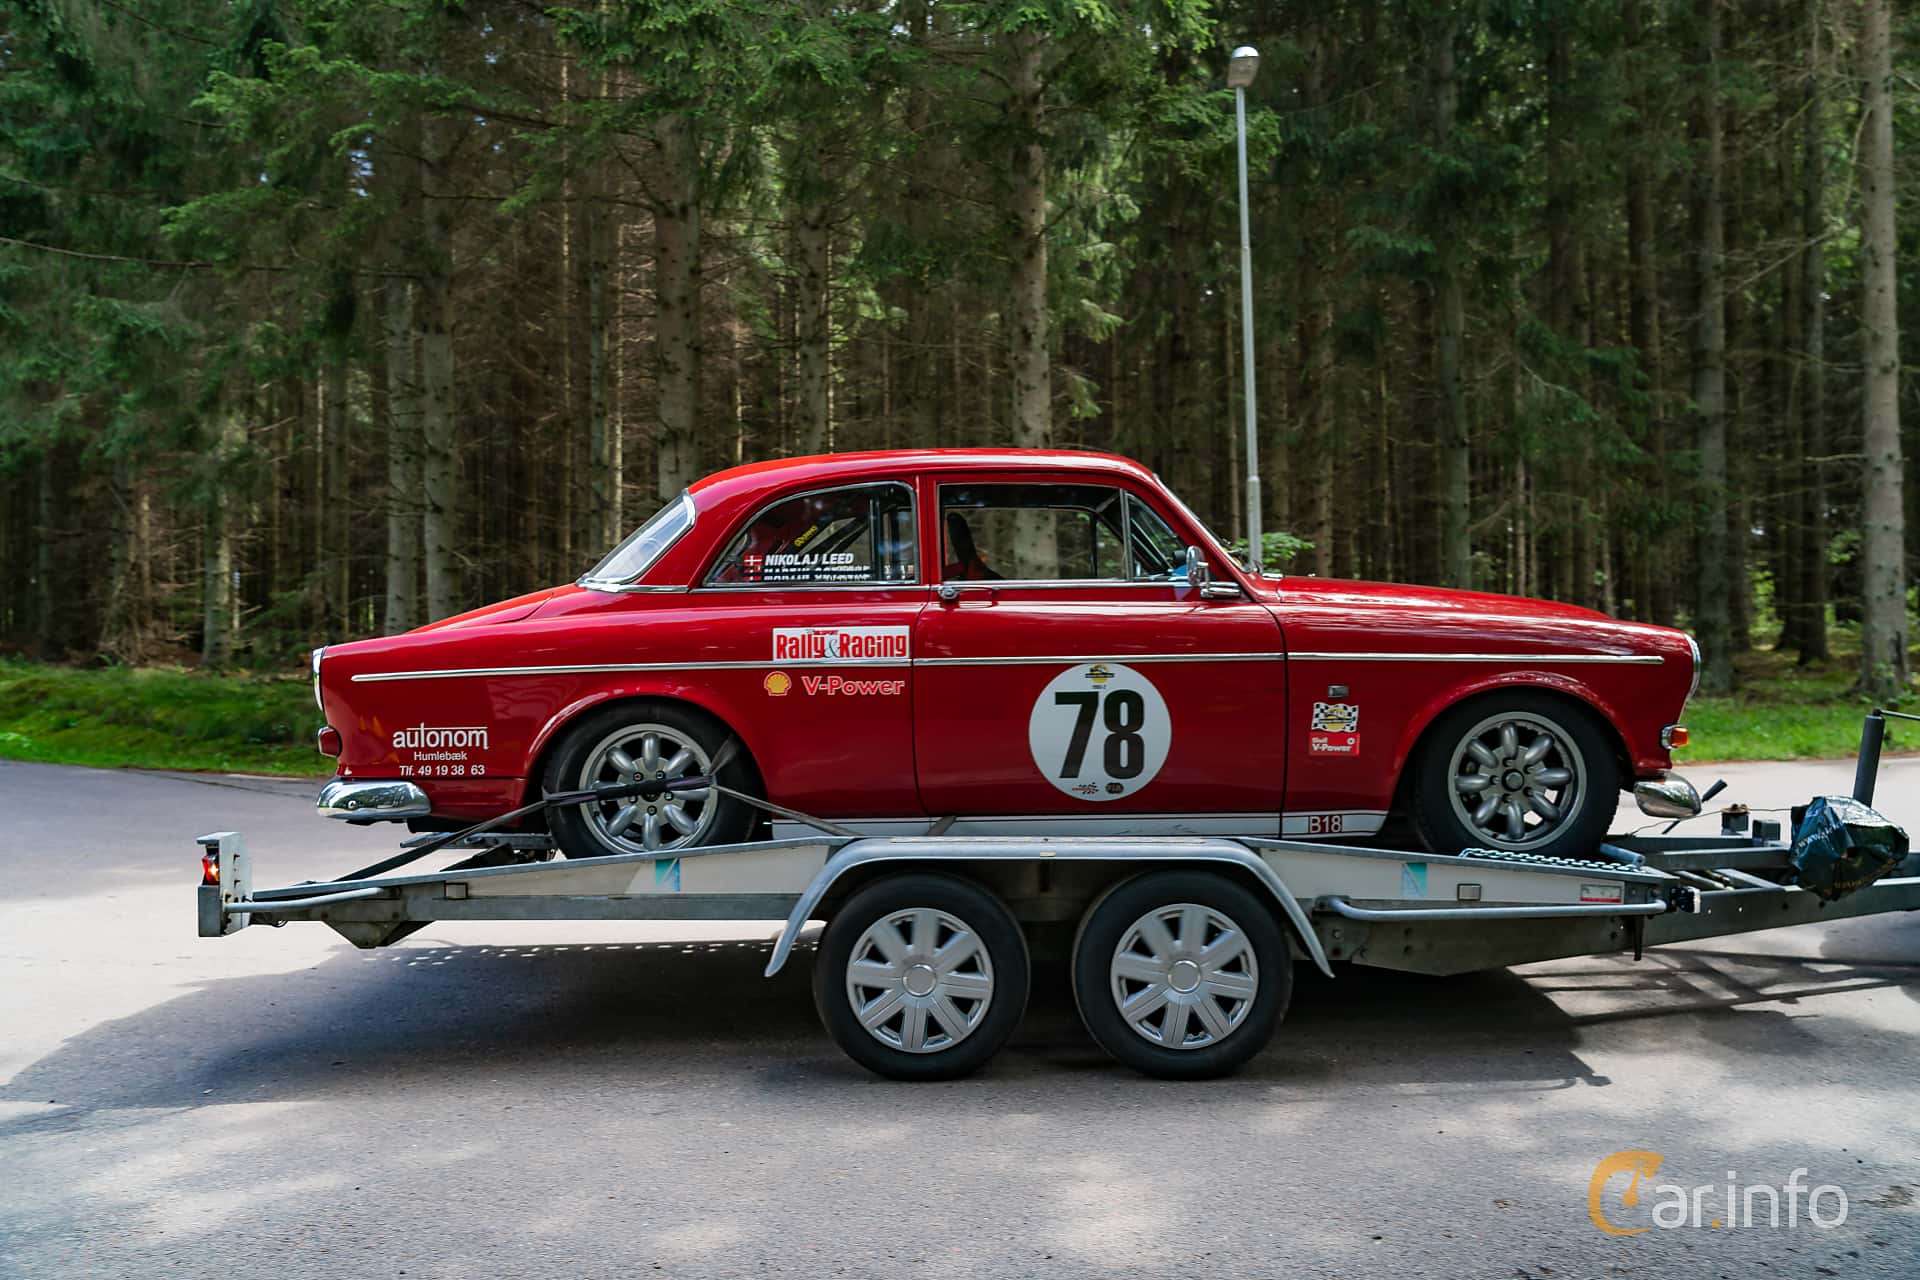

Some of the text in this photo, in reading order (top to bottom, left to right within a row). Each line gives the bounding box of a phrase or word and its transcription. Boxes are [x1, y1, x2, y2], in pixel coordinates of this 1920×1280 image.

[764, 553, 855, 567] NIKOLAJ LEED
[801, 675, 905, 696] V-Power
[392, 722, 489, 750] autonom
[1054, 689, 1145, 780] 78
[413, 751, 468, 761] Humlebæk
[418, 765, 432, 776] 49
[435, 765, 449, 776] 19
[451, 765, 465, 776] 38
[470, 765, 486, 776] 63
[1309, 815, 1341, 833] B18
